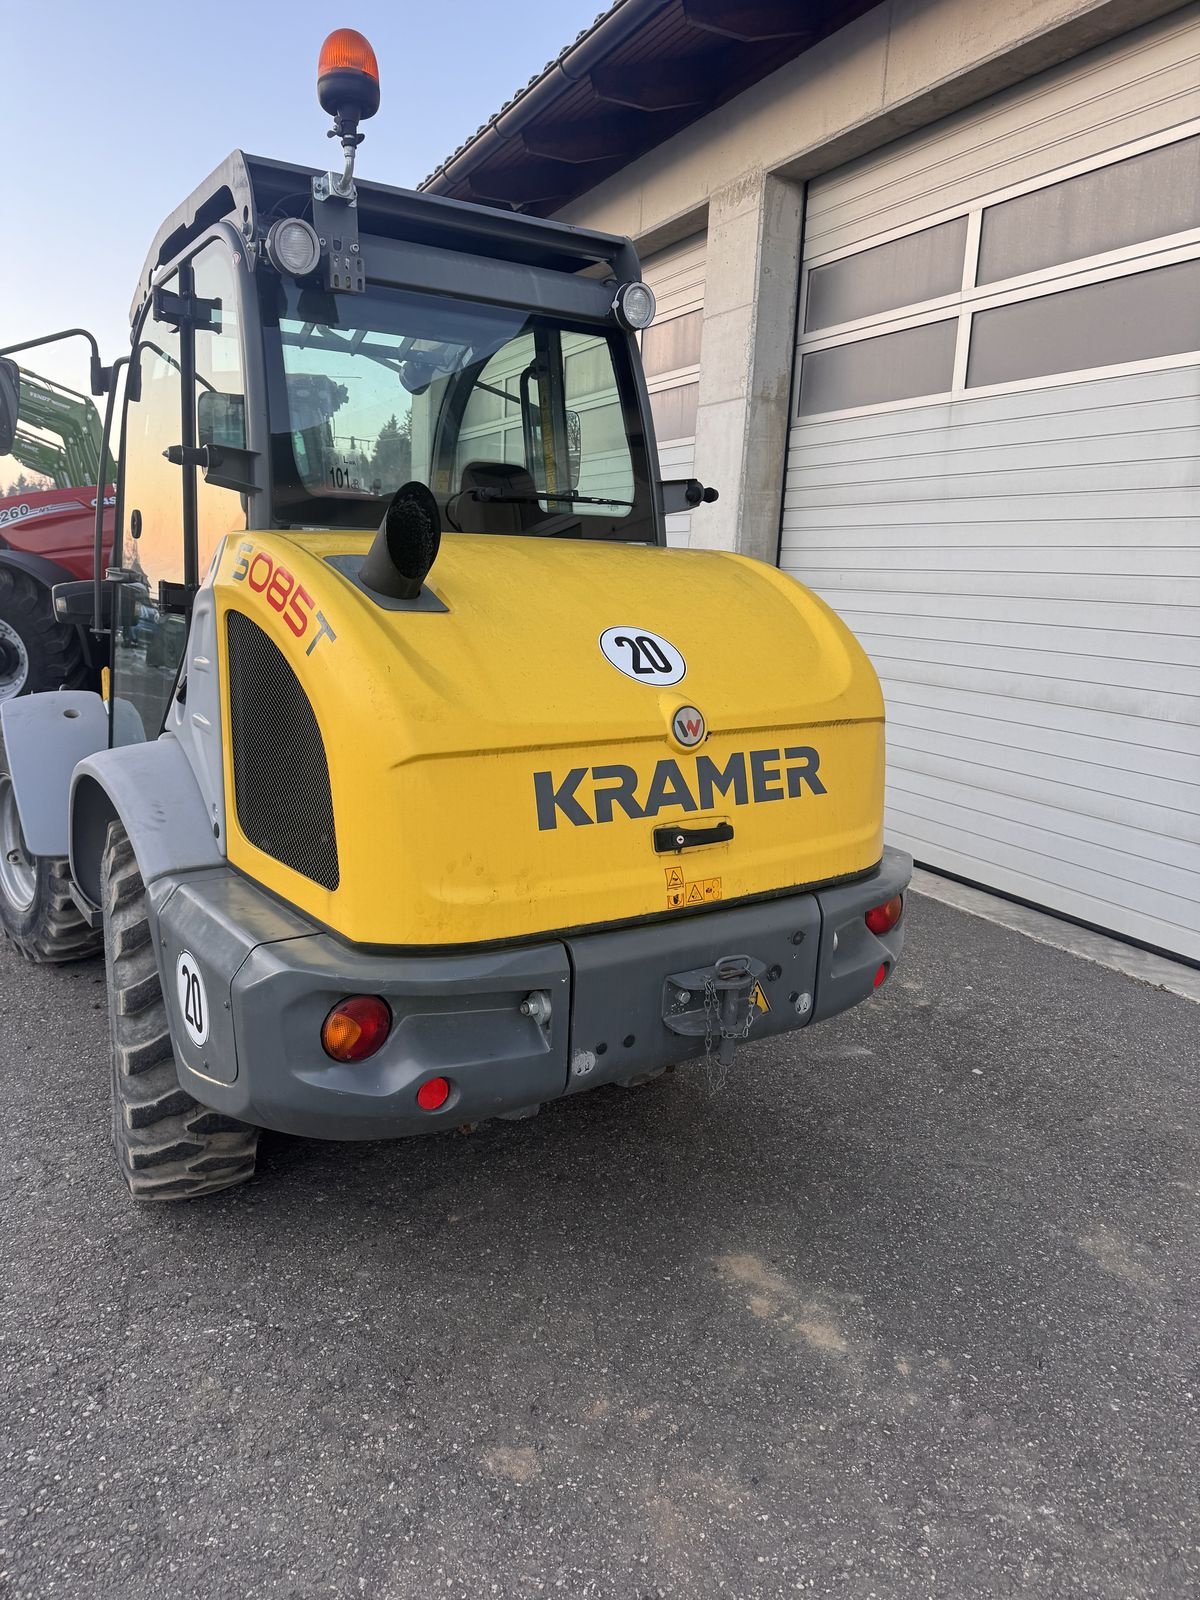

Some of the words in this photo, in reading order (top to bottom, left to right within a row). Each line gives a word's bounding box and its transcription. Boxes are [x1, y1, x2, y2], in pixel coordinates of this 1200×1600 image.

[329, 466, 350, 489] 101
[0, 504, 29, 523] 260
[91, 496, 117, 506] CAS
[232, 543, 337, 656] 5085T
[614, 635, 673, 675] 20
[533, 745, 828, 831] KRAMER
[182, 965, 203, 1034] 20
